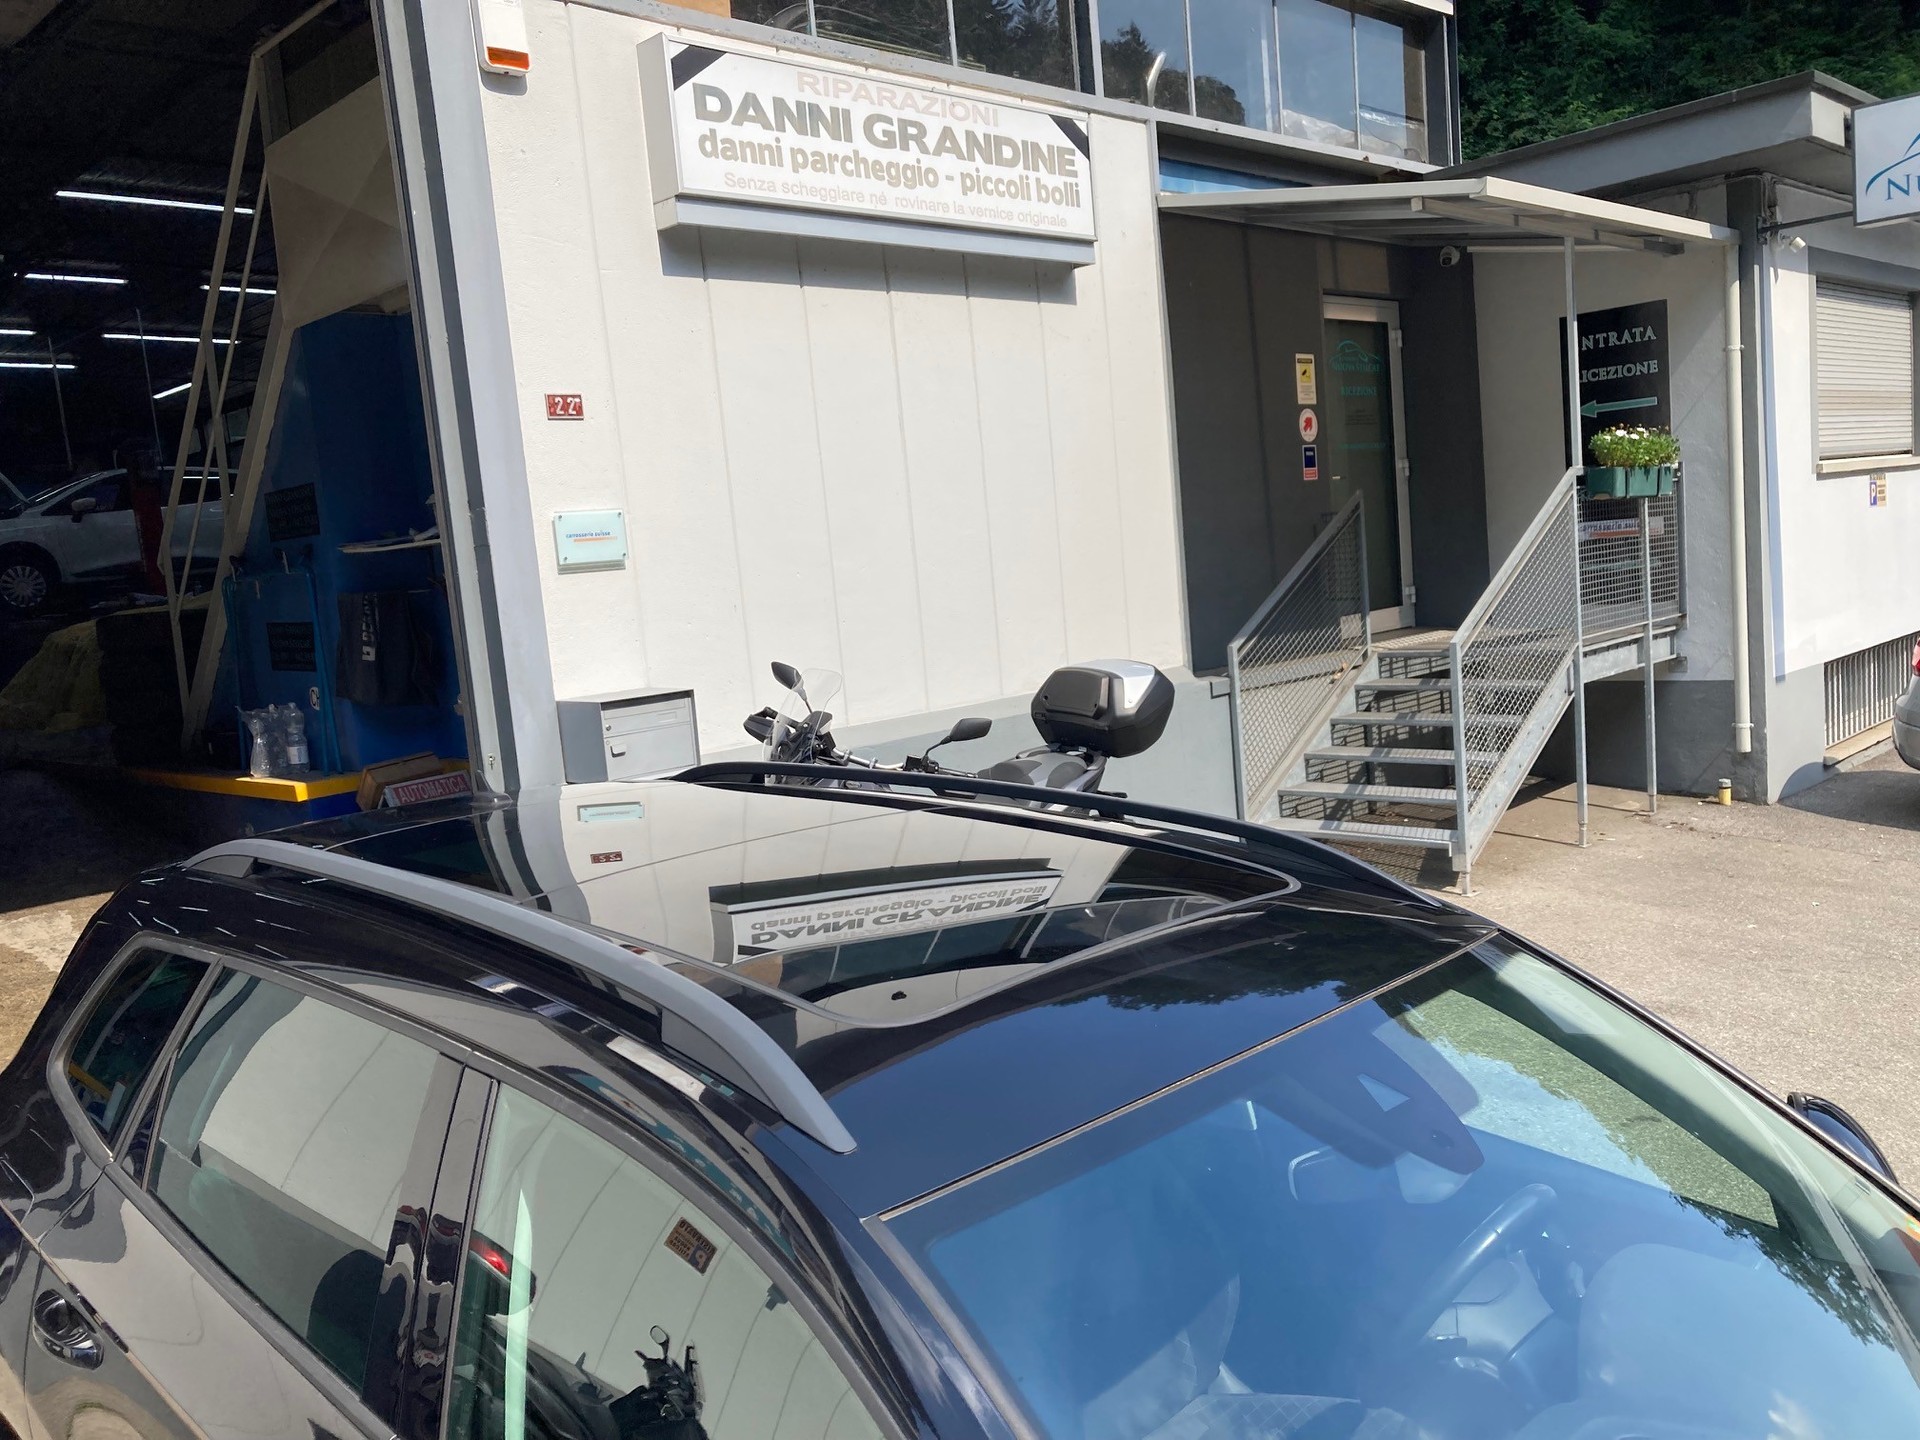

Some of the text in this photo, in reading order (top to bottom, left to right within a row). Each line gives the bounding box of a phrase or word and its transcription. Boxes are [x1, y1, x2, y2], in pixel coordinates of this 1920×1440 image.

[796, 72, 998, 128] RIPARAZIONI
[692, 82, 1078, 178] DANNI GRANDINE
[698, 128, 784, 167] danni
[790, 146, 939, 190] parcheggio
[960, 167, 1031, 201] piccoli
[1035, 177, 1081, 208] bolli
[1884, 173, 1920, 201] N
[724, 172, 777, 193] Senza
[781, 180, 865, 203] scheggiare
[895, 195, 950, 214] rovinare
[953, 200, 966, 215] la
[969, 205, 1014, 220] vernice
[1017, 212, 1067, 228] originale
[1578, 325, 1657, 351] NTRATA
[1579, 360, 1659, 383] ICEZIONE
[398, 776, 467, 803] AUTOMATICA
